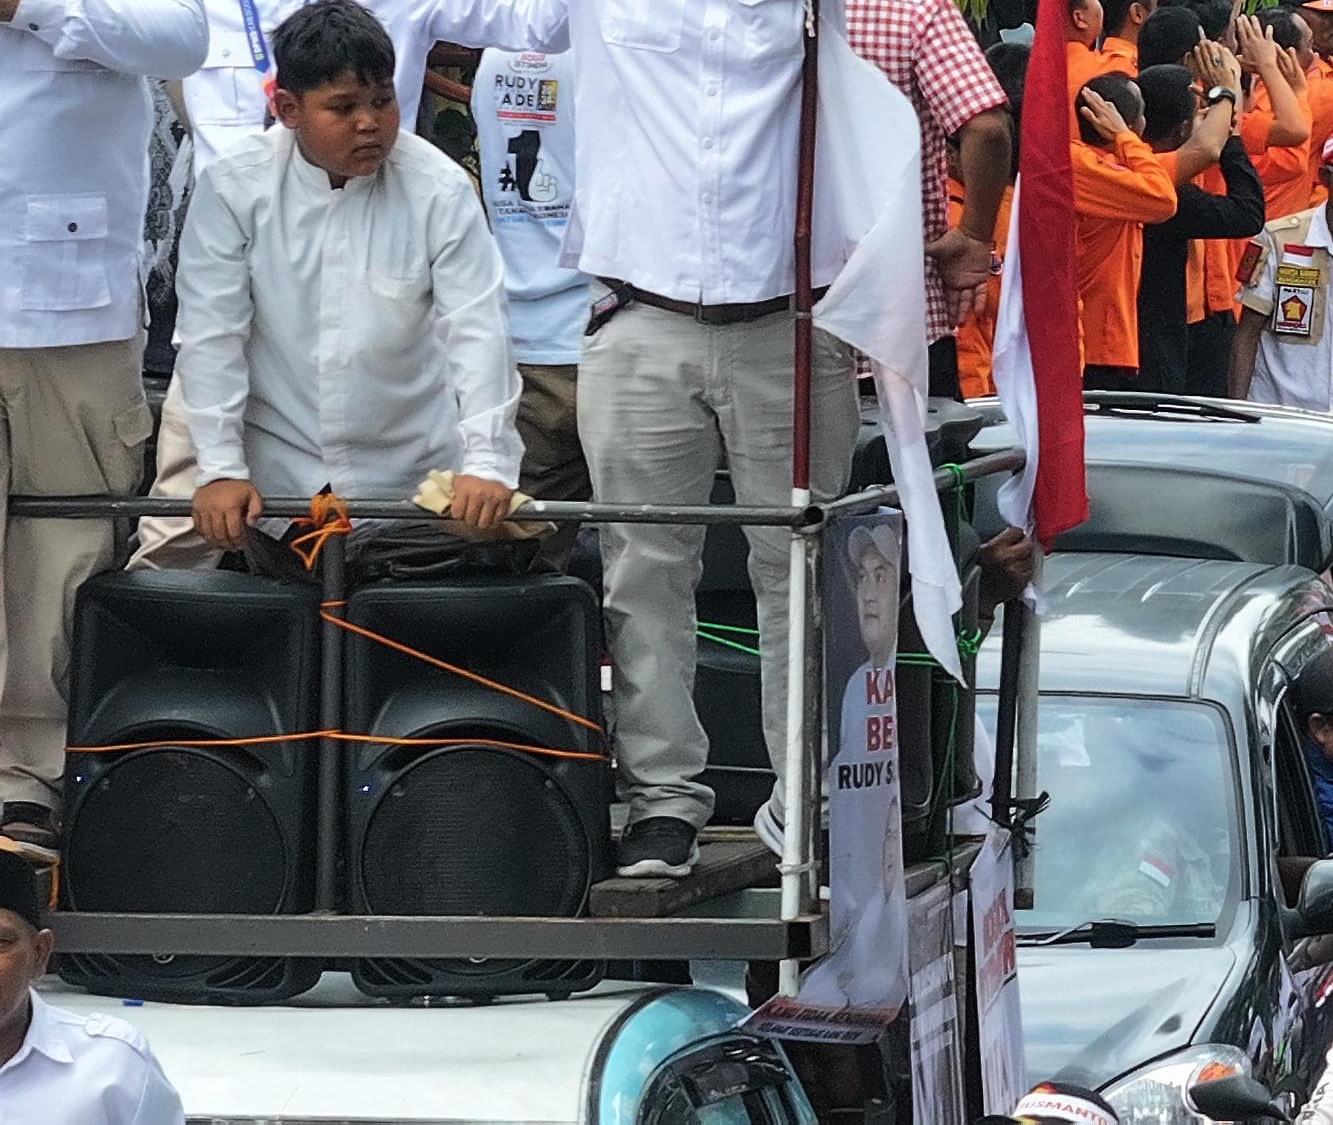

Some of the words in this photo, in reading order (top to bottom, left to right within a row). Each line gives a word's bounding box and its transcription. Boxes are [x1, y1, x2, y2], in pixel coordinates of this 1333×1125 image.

[495, 75, 538, 89] RUDY
[502, 93, 538, 107] ADE
[839, 763, 879, 790] RUDY
